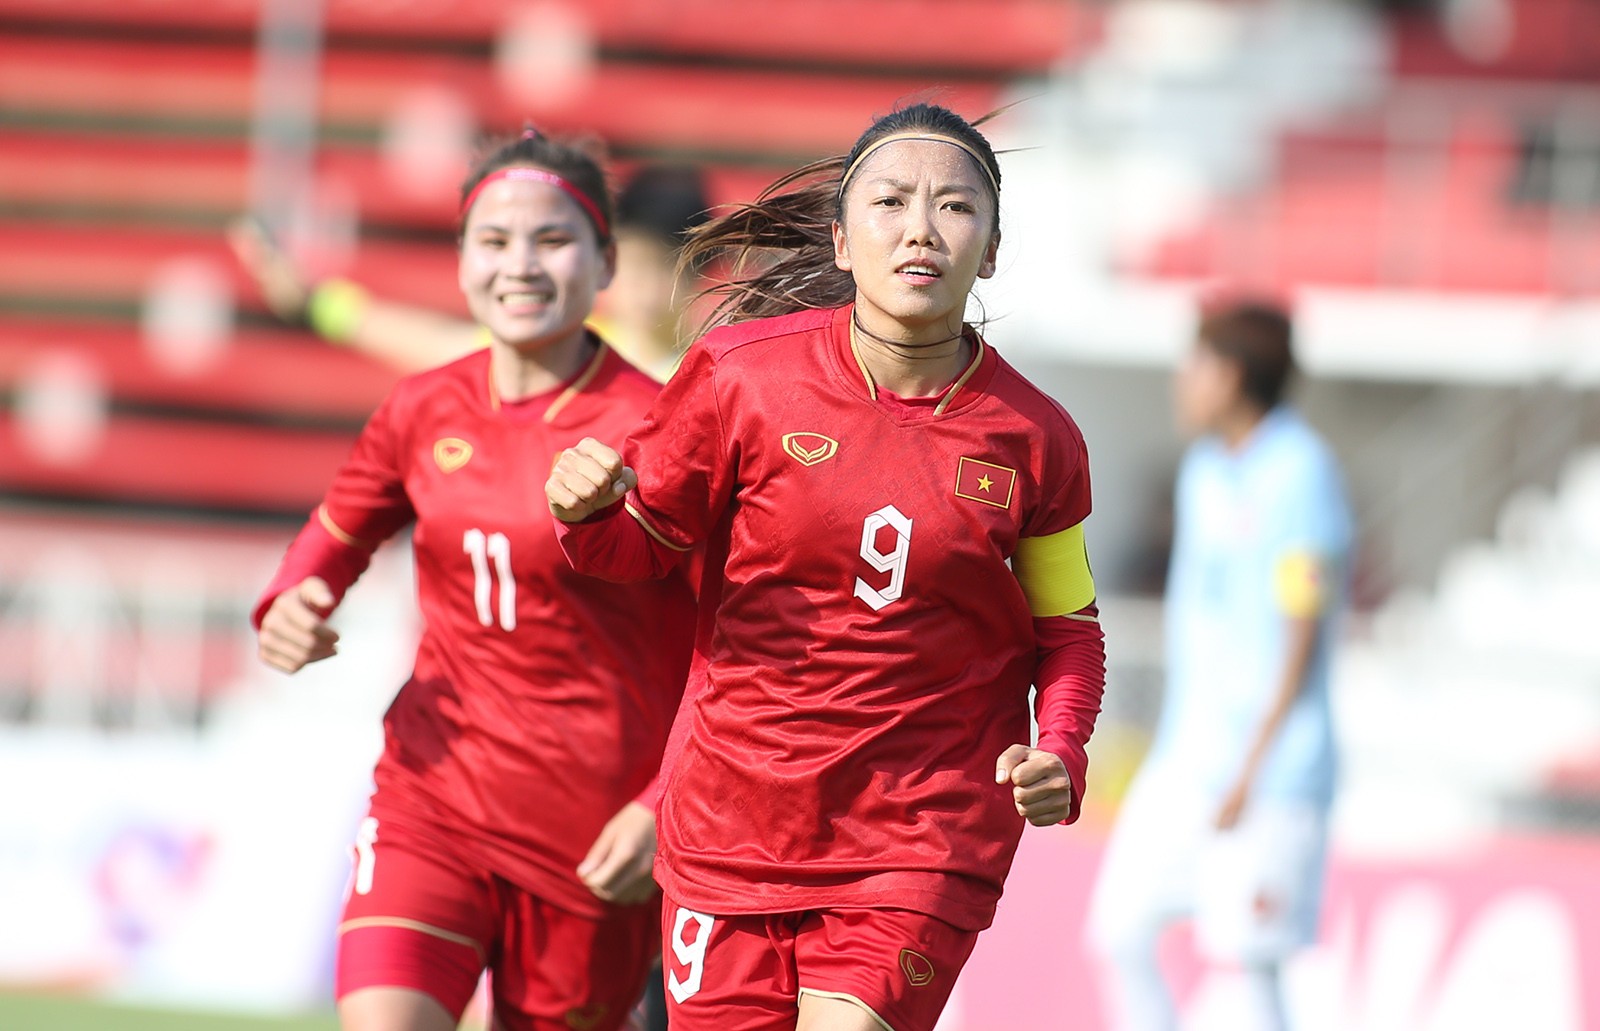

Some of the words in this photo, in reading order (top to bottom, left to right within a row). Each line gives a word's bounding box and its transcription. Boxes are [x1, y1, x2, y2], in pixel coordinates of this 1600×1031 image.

[463, 528, 516, 632] 11
[853, 504, 913, 612] 9
[667, 907, 715, 1005] 9
